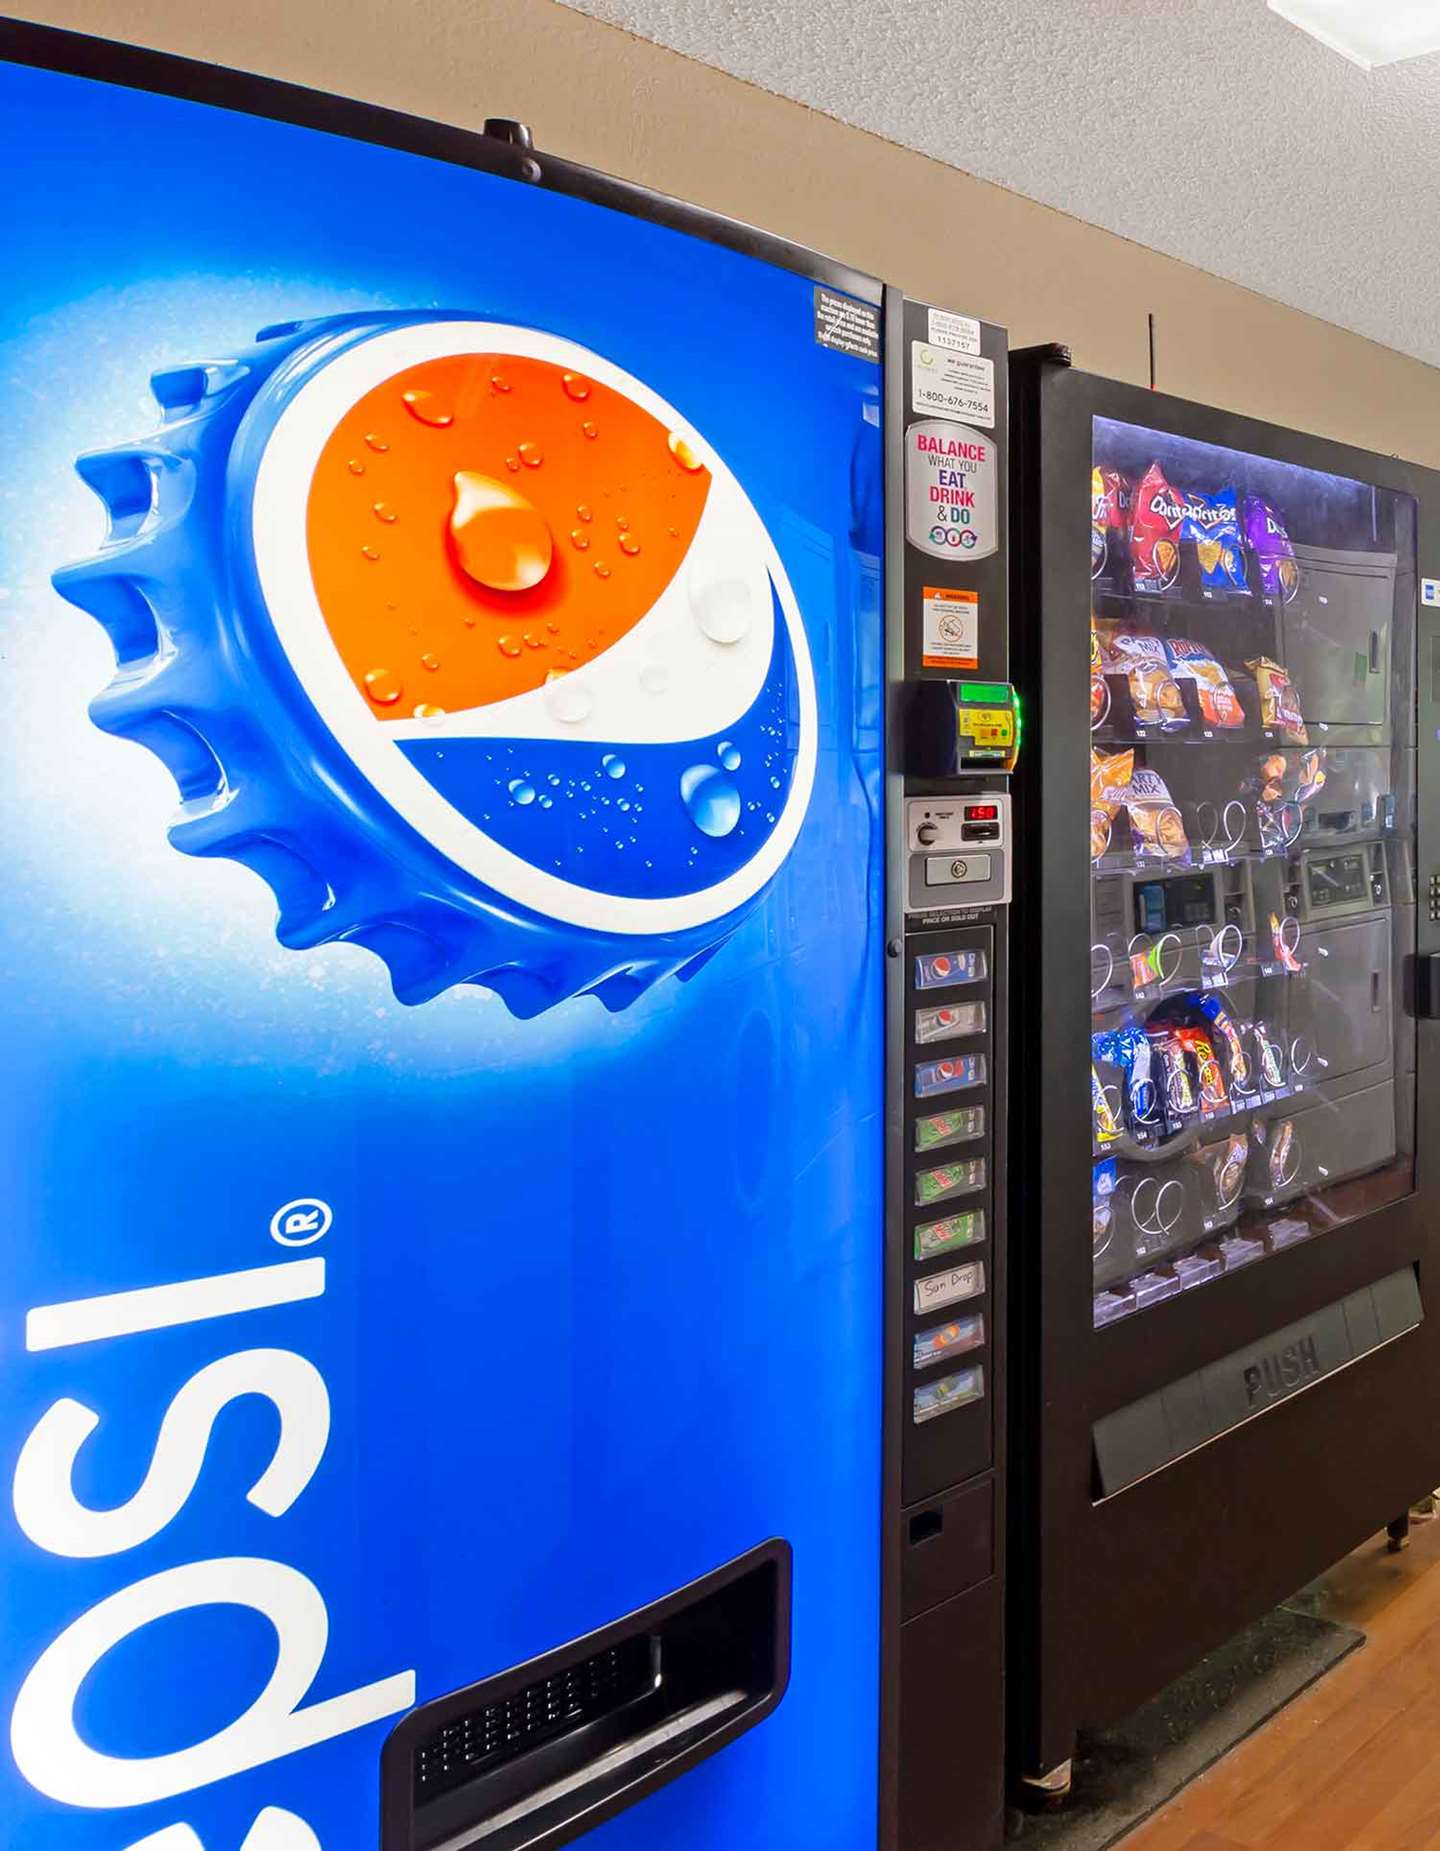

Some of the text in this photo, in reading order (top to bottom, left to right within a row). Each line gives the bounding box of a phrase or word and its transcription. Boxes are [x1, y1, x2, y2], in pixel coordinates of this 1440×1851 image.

[919, 388, 988, 412] 1-800-676-7554
[917, 434, 985, 462] BALANCE
[928, 454, 978, 474] WHAT YOU
[939, 469, 966, 489] EAT
[929, 486, 976, 508] DRINK
[937, 505, 970, 525] & DO
[1133, 784, 1159, 795] MIX
[924, 1271, 973, 1296] Sun Drop
[1243, 1335, 1320, 1408] PUSH
[10, 1256, 416, 1851] psi
